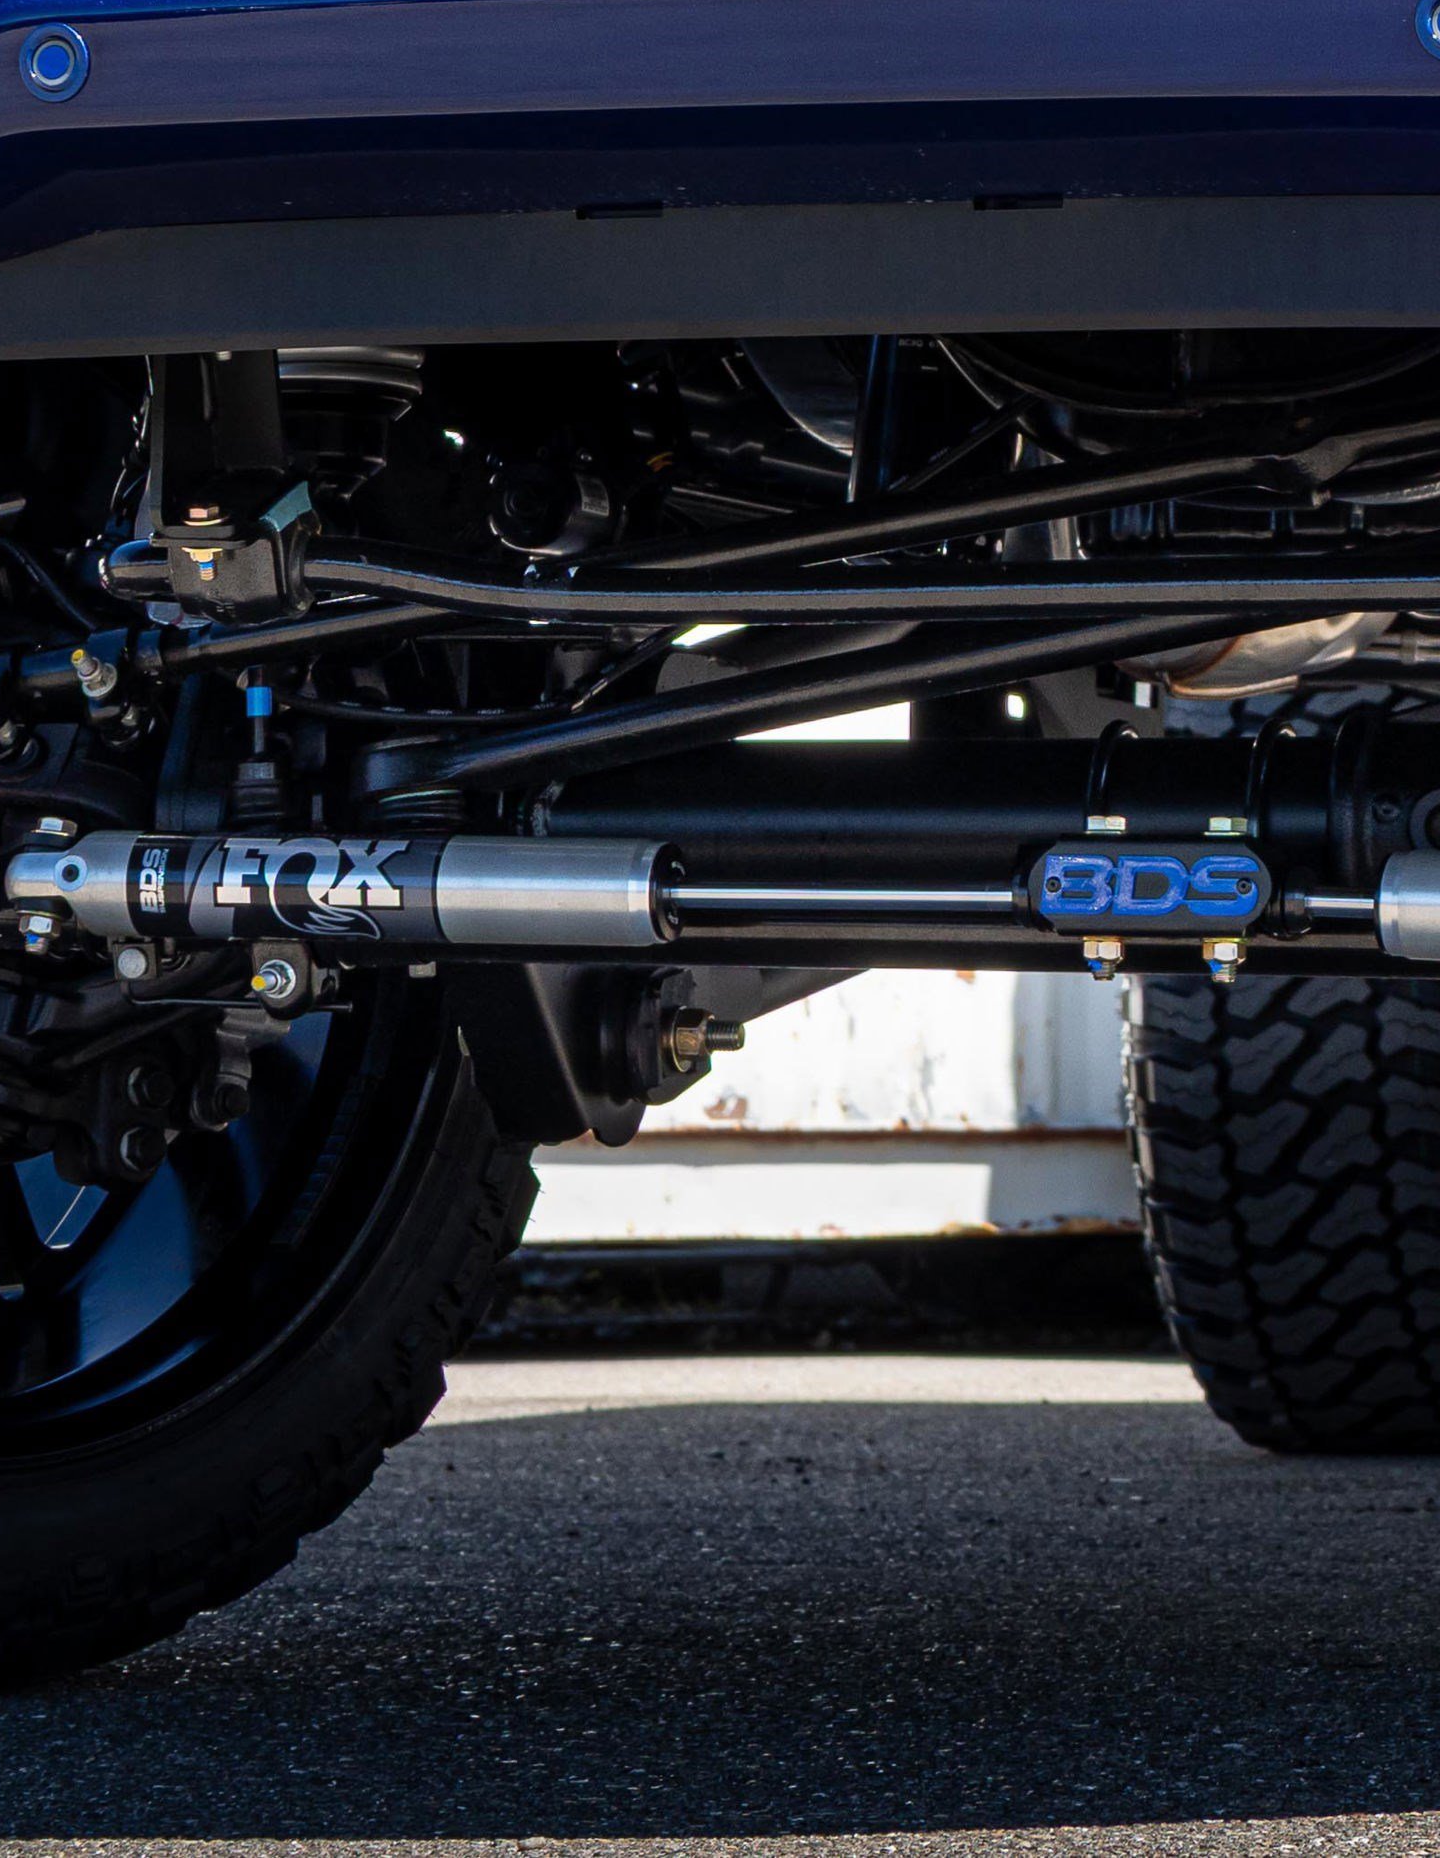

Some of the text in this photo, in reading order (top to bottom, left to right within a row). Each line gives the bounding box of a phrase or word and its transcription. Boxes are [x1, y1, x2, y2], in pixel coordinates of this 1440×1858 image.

[139, 848, 162, 913] BDS
[215, 837, 410, 939] FOX
[1040, 855, 1258, 916] BDS
